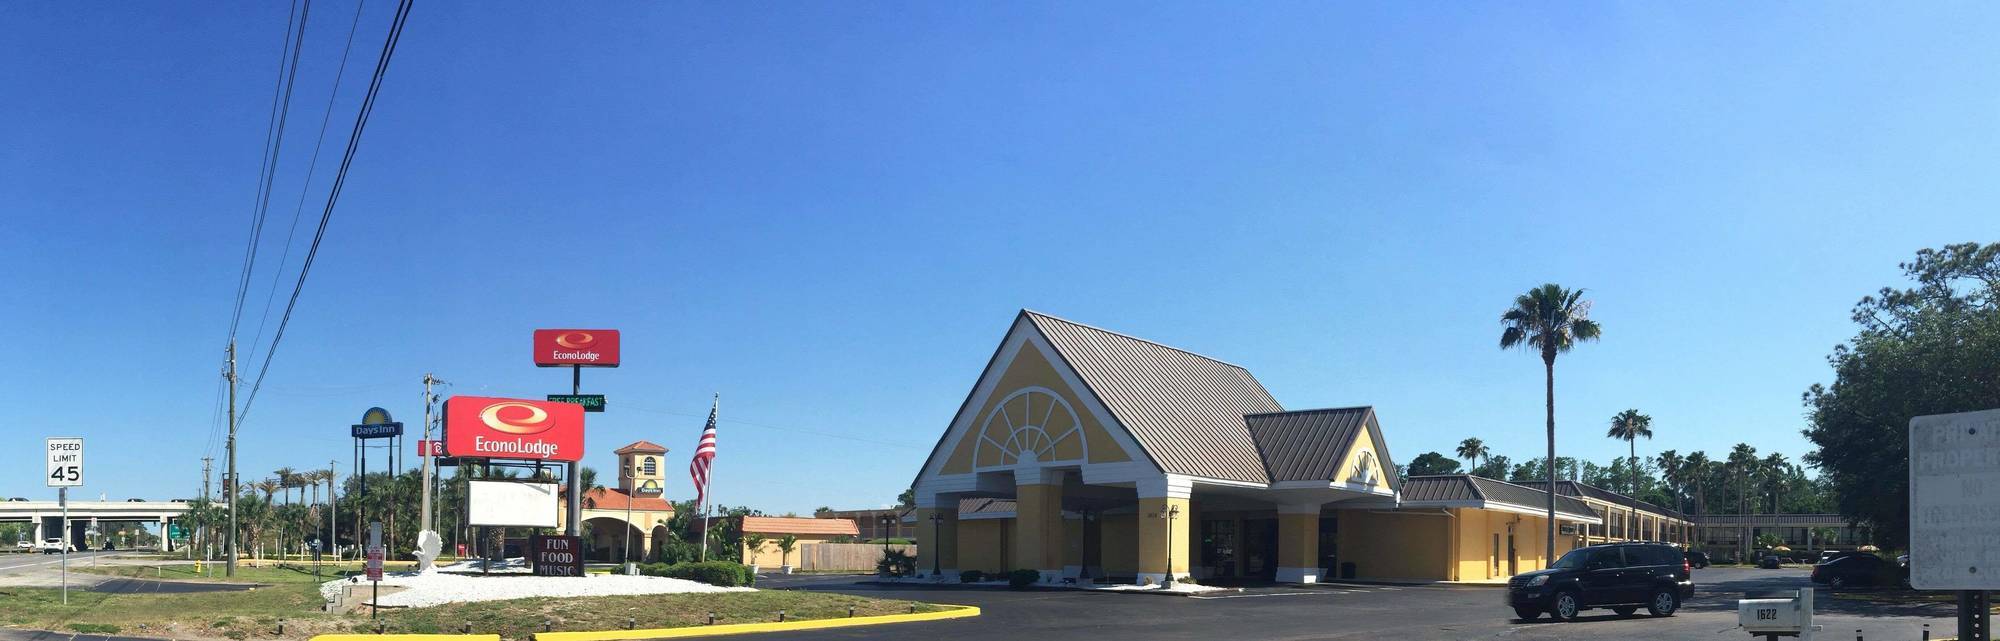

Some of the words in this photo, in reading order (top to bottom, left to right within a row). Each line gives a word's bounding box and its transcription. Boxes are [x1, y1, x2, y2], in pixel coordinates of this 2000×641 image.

[553, 350, 600, 362] EconoLodge
[356, 426, 379, 435] Days
[380, 425, 395, 434] Inn
[50, 443, 81, 451] SPEED
[475, 435, 558, 458] EconoLodge
[53, 454, 77, 462] LIMIT
[51, 466, 80, 481] 45
[546, 538, 569, 550] FUN
[541, 551, 574, 563] FOOD
[540, 564, 575, 576] MUSIC
[1757, 608, 1777, 620] 1622
